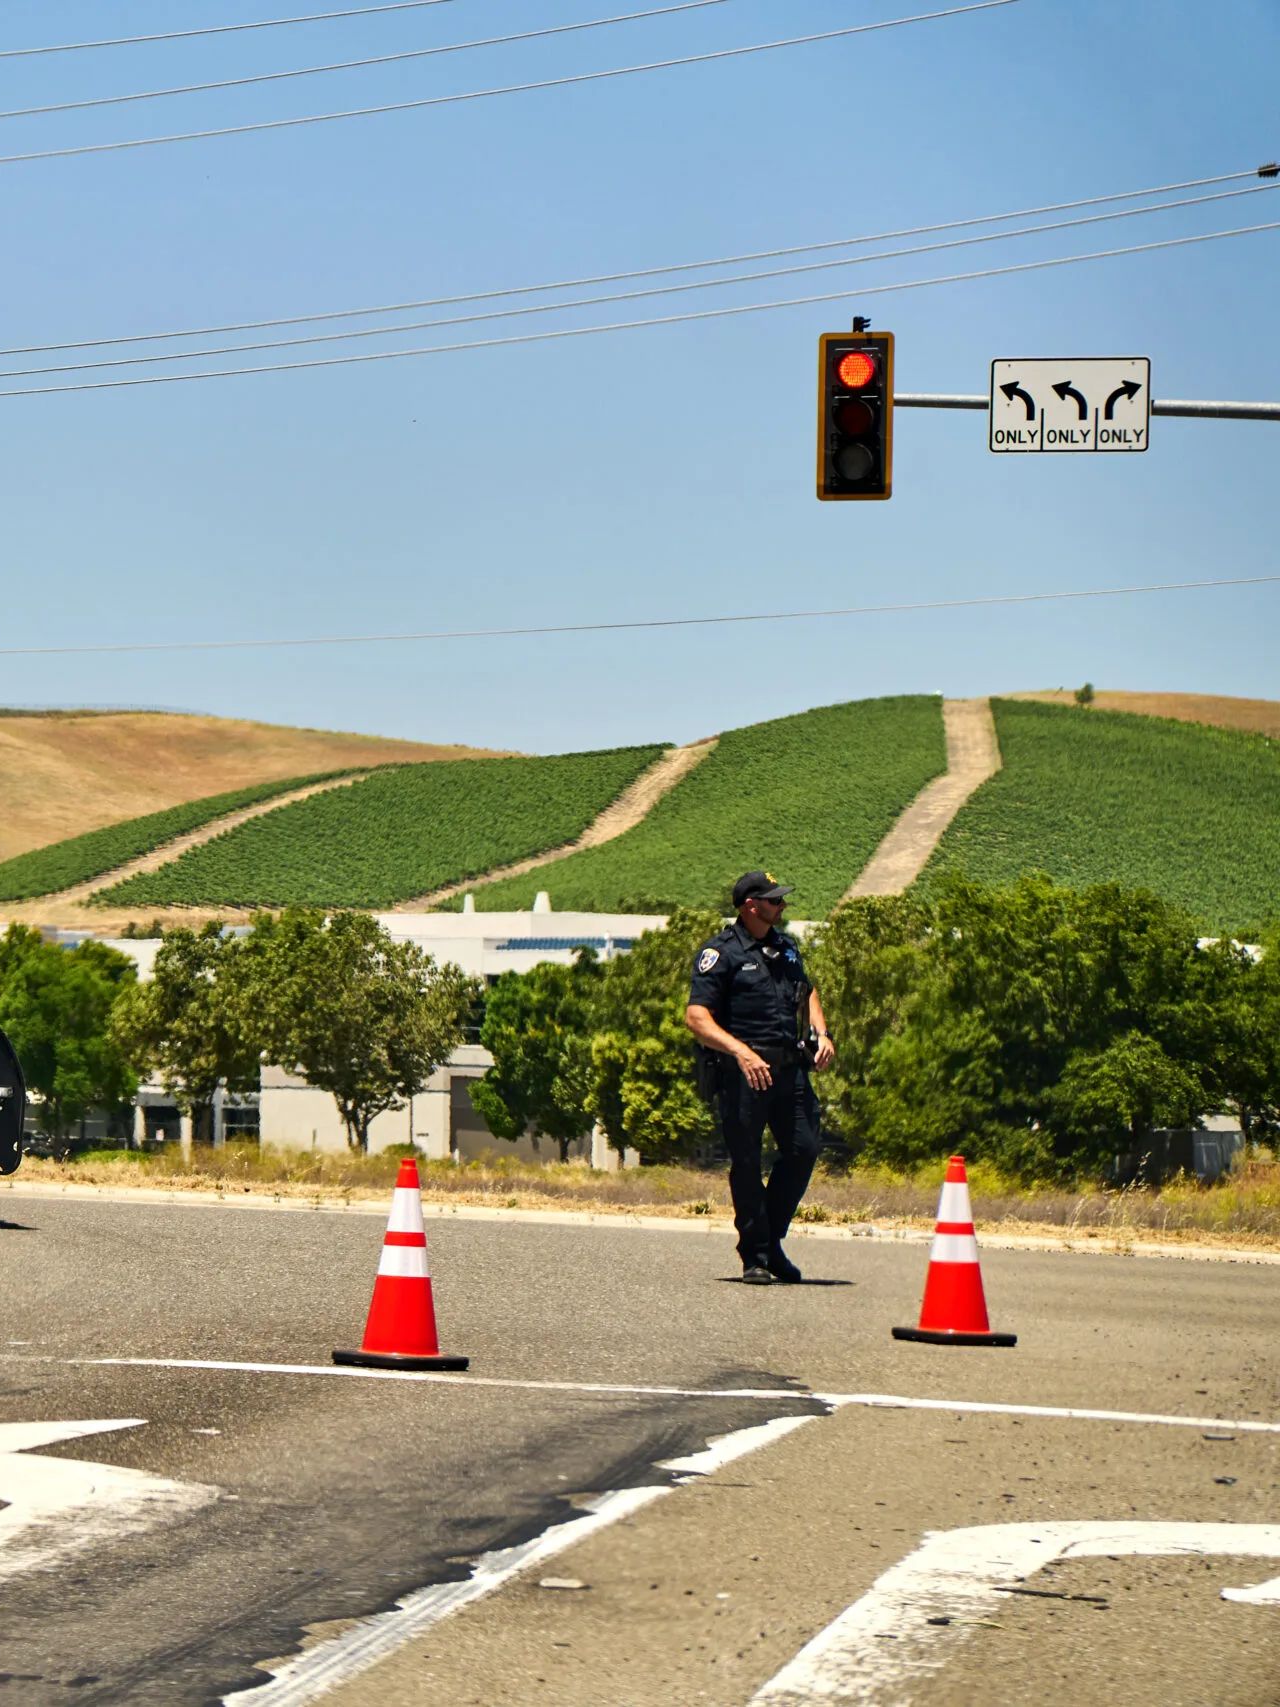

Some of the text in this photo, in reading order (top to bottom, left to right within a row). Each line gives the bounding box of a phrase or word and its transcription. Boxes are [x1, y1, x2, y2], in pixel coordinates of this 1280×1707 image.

[994, 428, 1144, 444] ONLY ONLY ONLY
